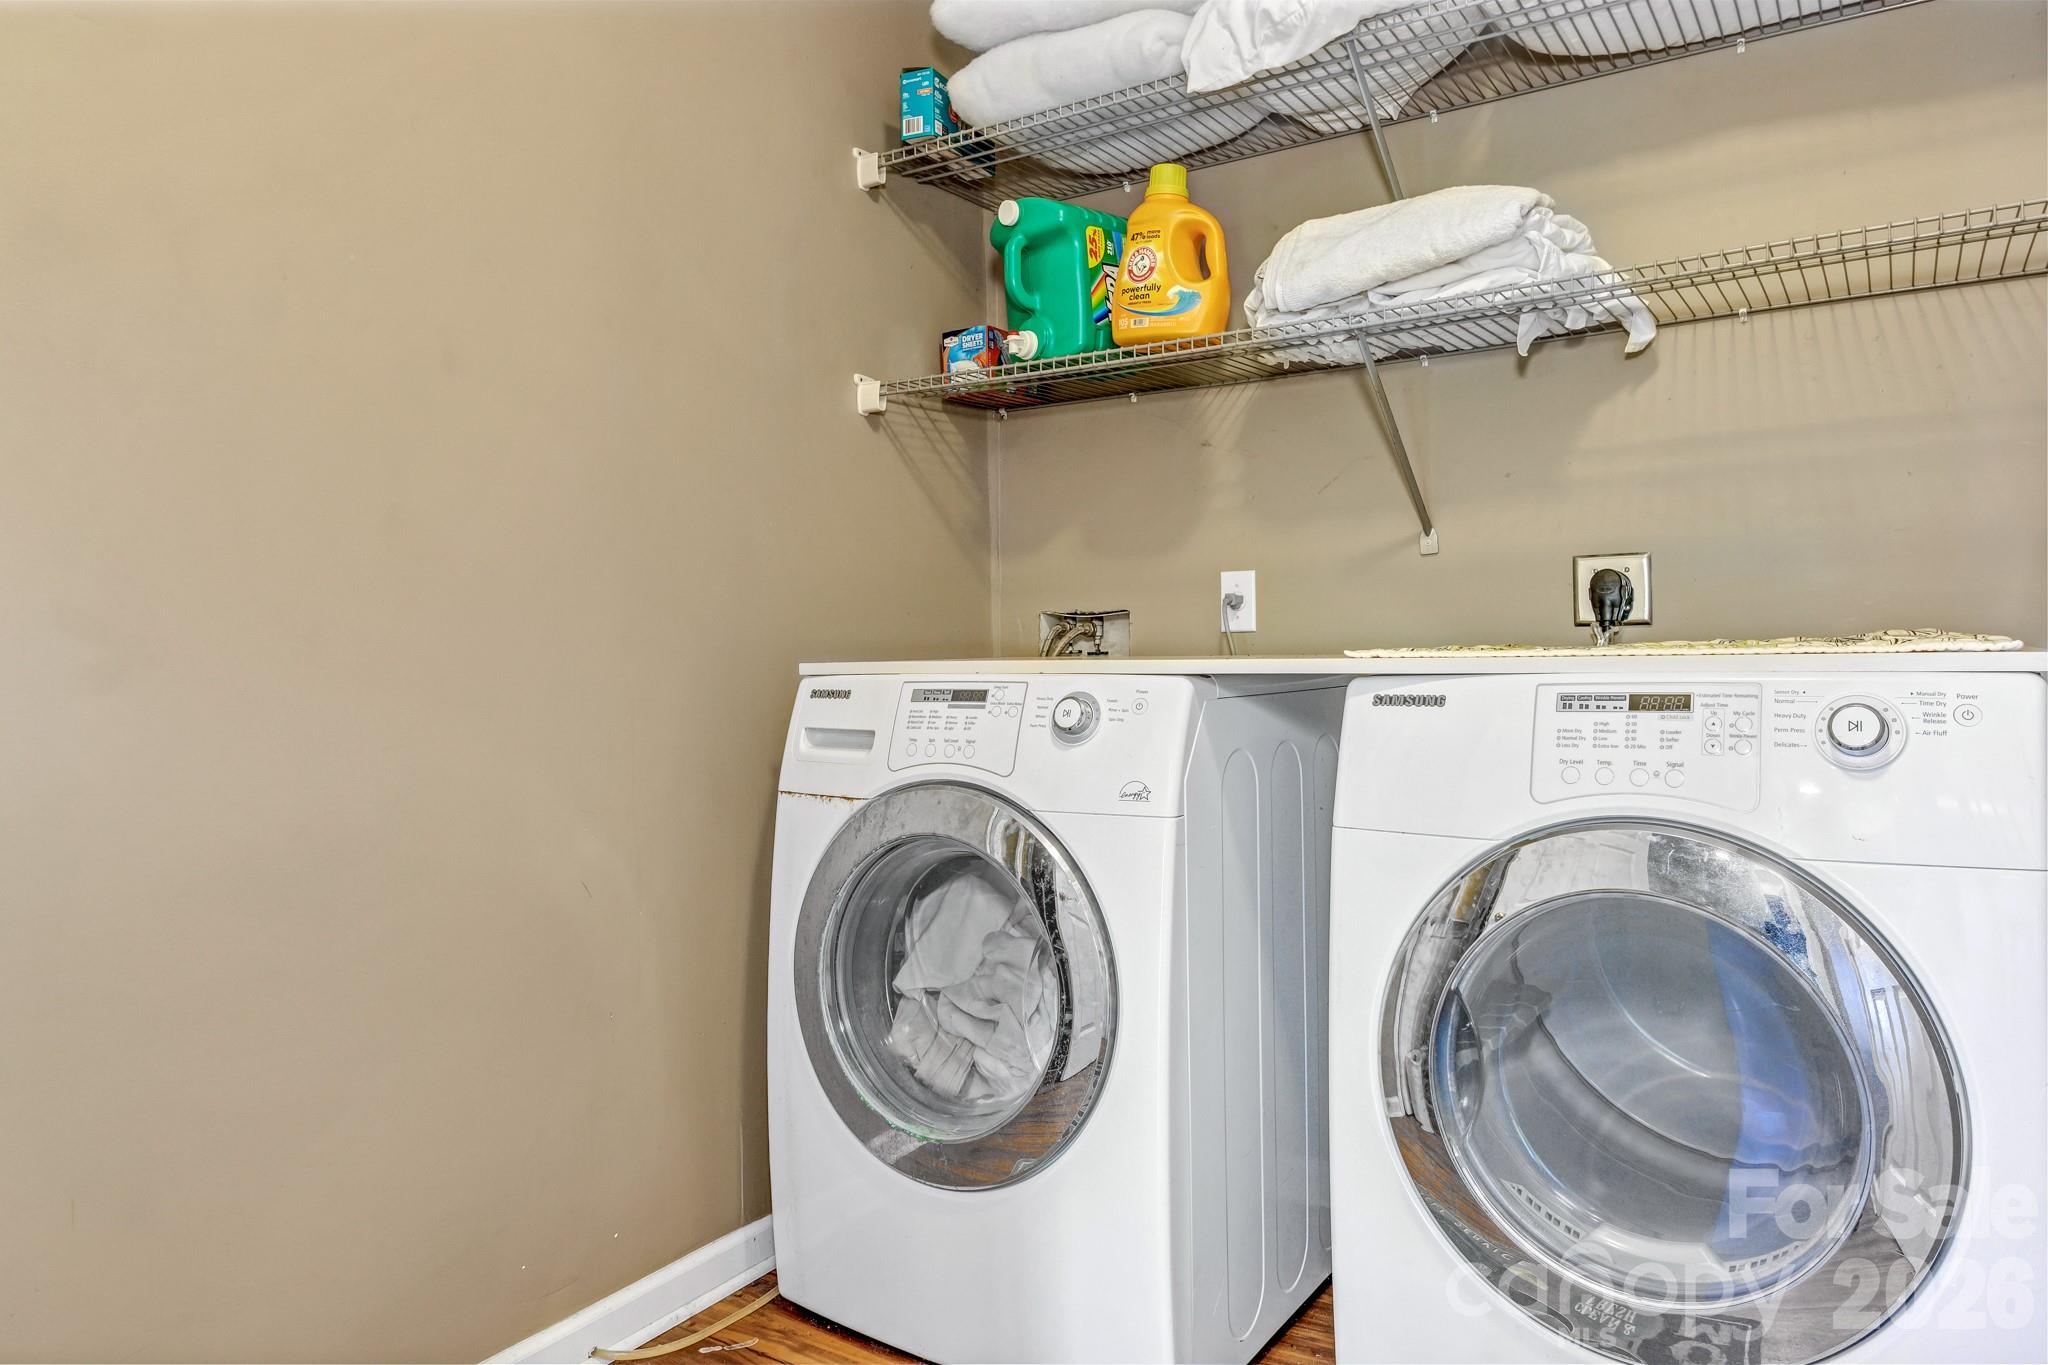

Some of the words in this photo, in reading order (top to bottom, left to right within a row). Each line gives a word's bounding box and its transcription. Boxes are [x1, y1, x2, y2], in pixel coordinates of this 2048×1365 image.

[1131, 232, 1146, 241] 47%
[1121, 283, 1162, 296] powerfully
[1129, 293, 1150, 301] clean
[962, 332, 984, 342] DRYER
[962, 340, 984, 349] SHEETS
[810, 688, 852, 699] SAMSUNG
[1372, 693, 1446, 707] SAMSUNG
[1559, 758, 1569, 766] Dry
[1666, 761, 1685, 769] Signal
